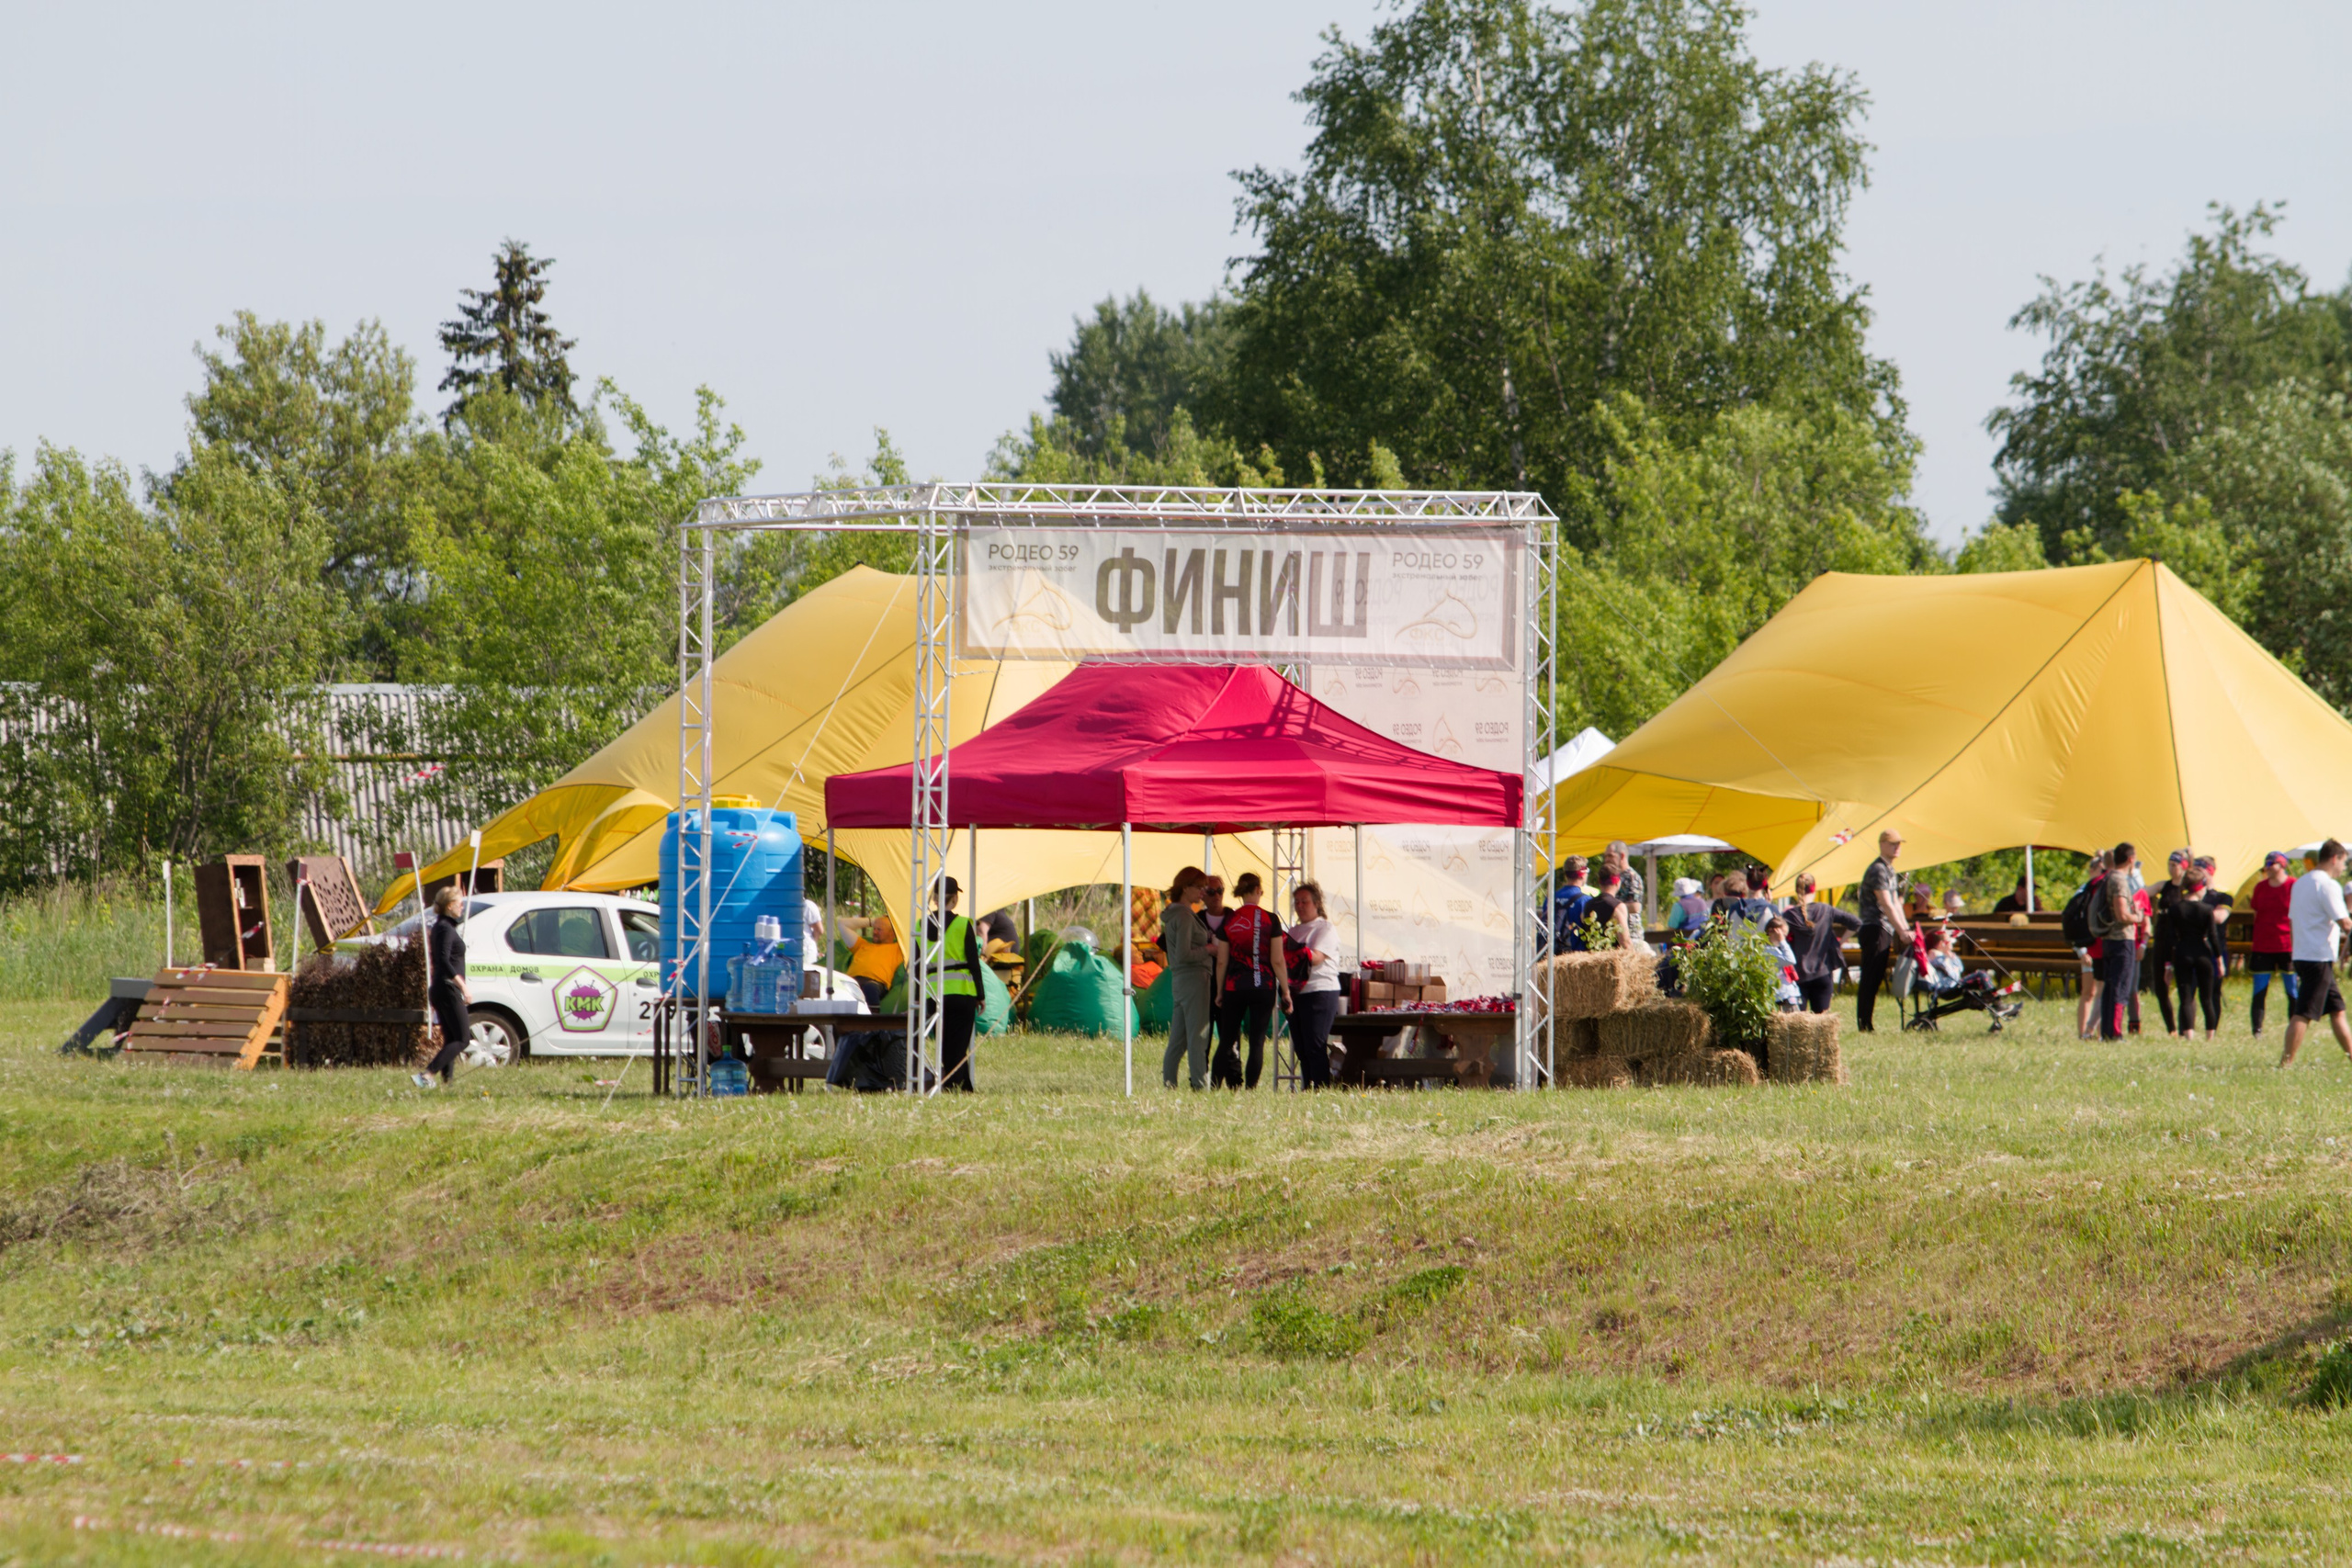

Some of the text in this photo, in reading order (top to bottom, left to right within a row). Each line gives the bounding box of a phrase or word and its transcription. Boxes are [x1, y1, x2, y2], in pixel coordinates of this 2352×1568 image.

[988, 544, 1080, 562] РОДЕО 59
[1392, 552, 1484, 570] РОДЕО 59
[1095, 547, 1371, 637] ФИНИШ
[470, 964, 539, 974] ОХРАНА ДОМОВ
[643, 970, 660, 978] ОХР
[564, 996, 605, 1012] КМК
